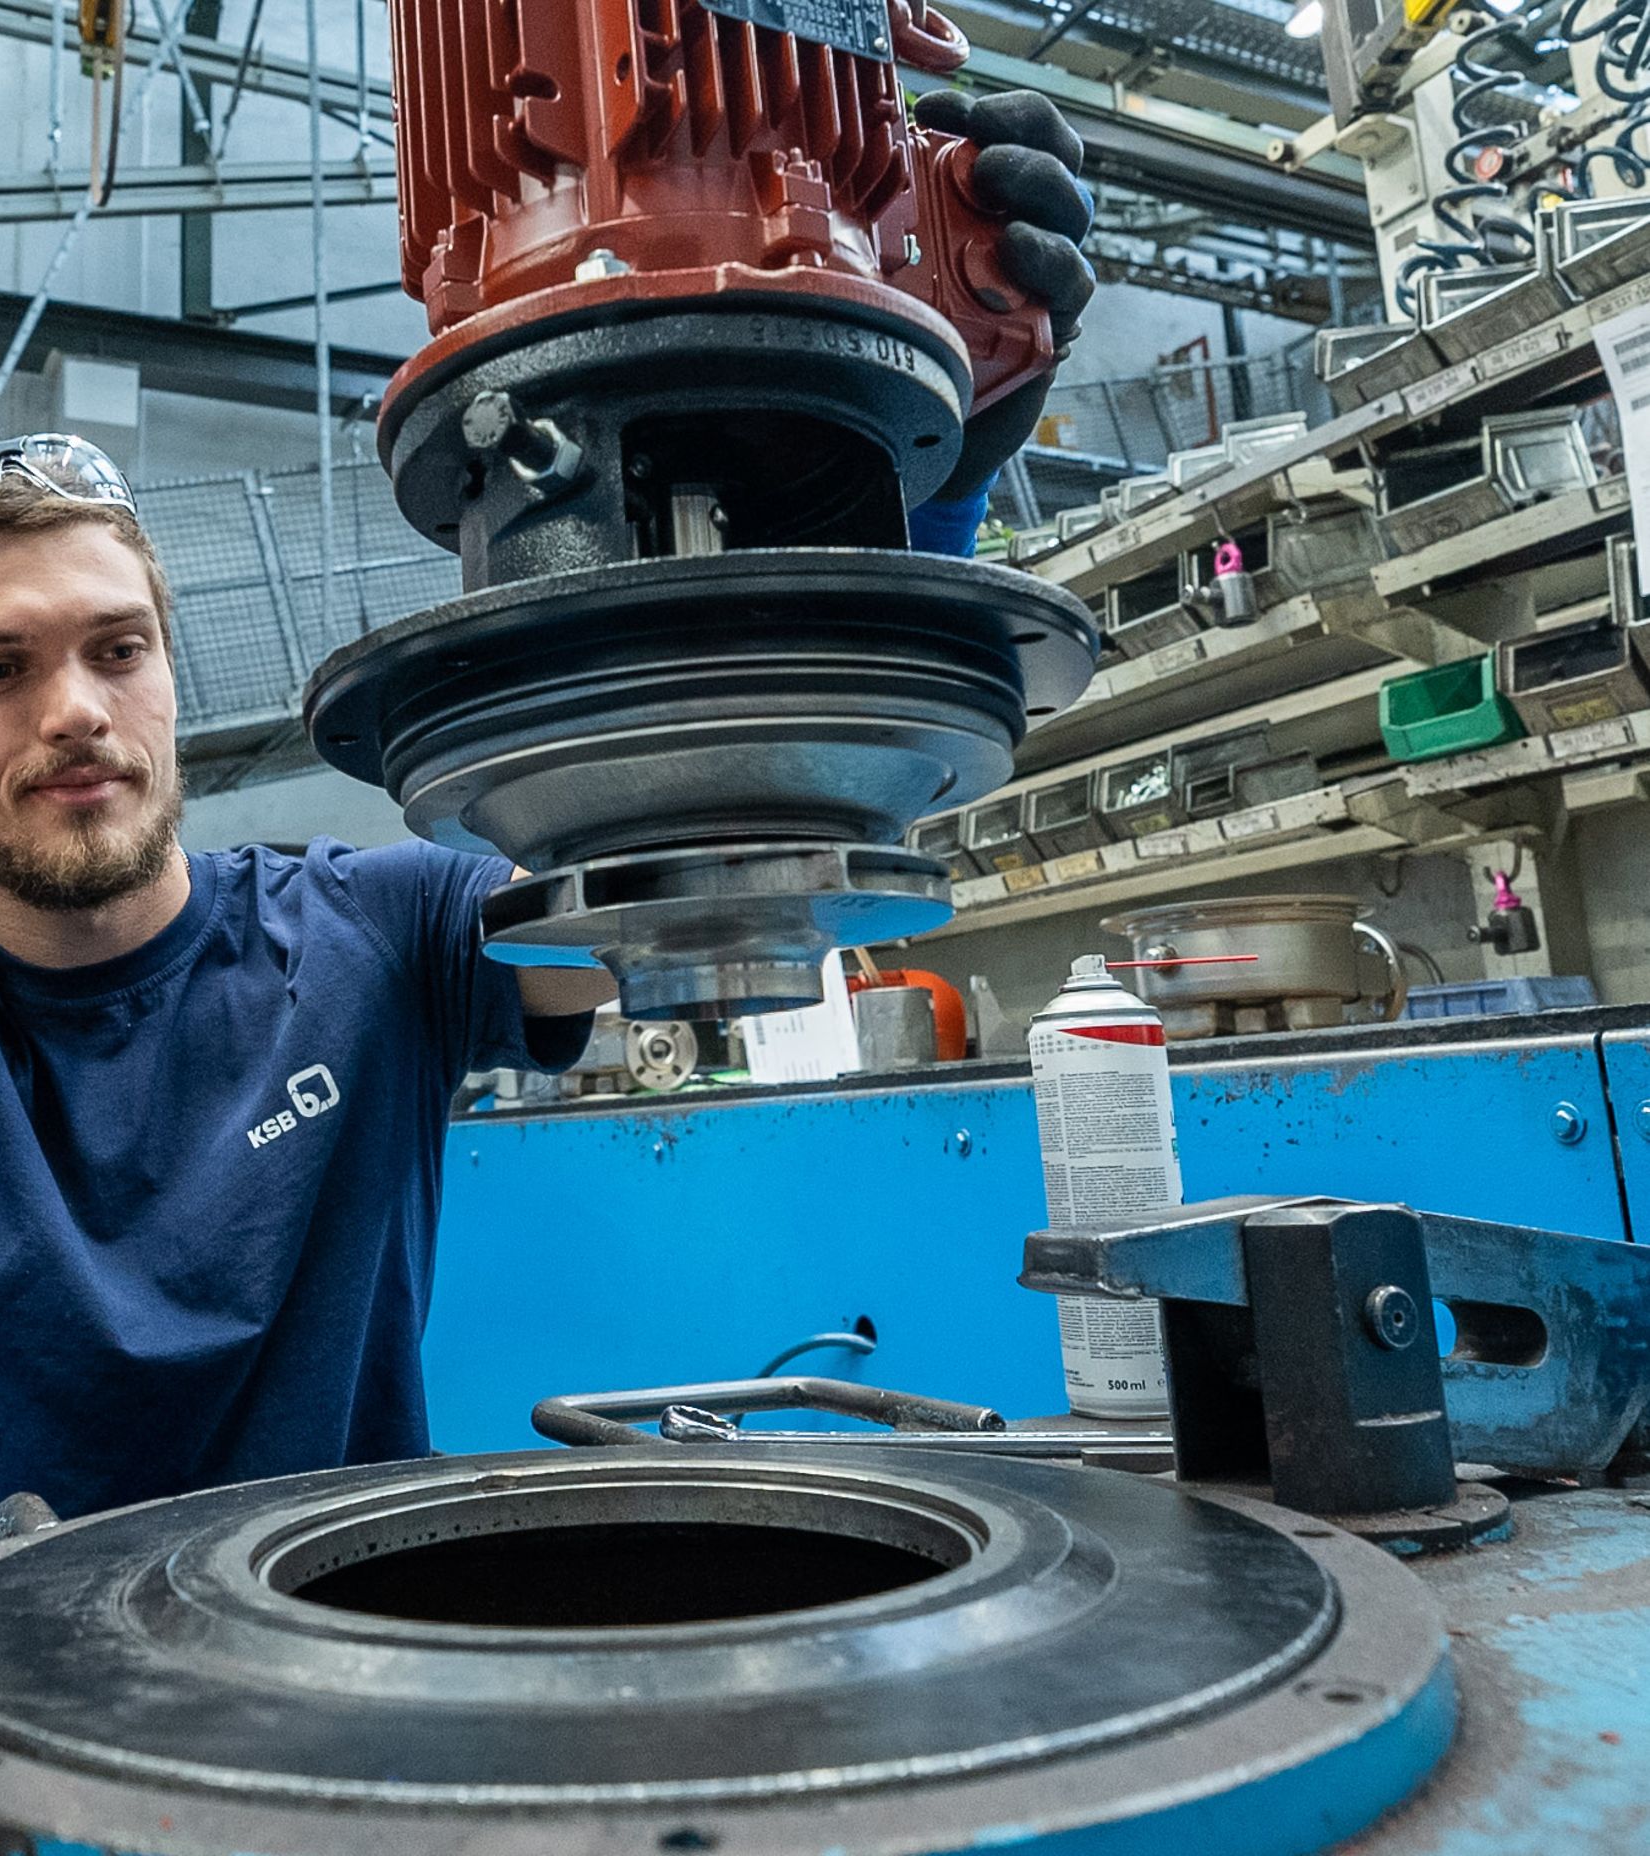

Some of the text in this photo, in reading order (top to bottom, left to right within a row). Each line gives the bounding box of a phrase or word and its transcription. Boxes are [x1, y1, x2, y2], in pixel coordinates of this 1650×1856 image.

[246, 1109, 298, 1150] KSB
[1107, 1379, 1147, 1391] 500 ml
